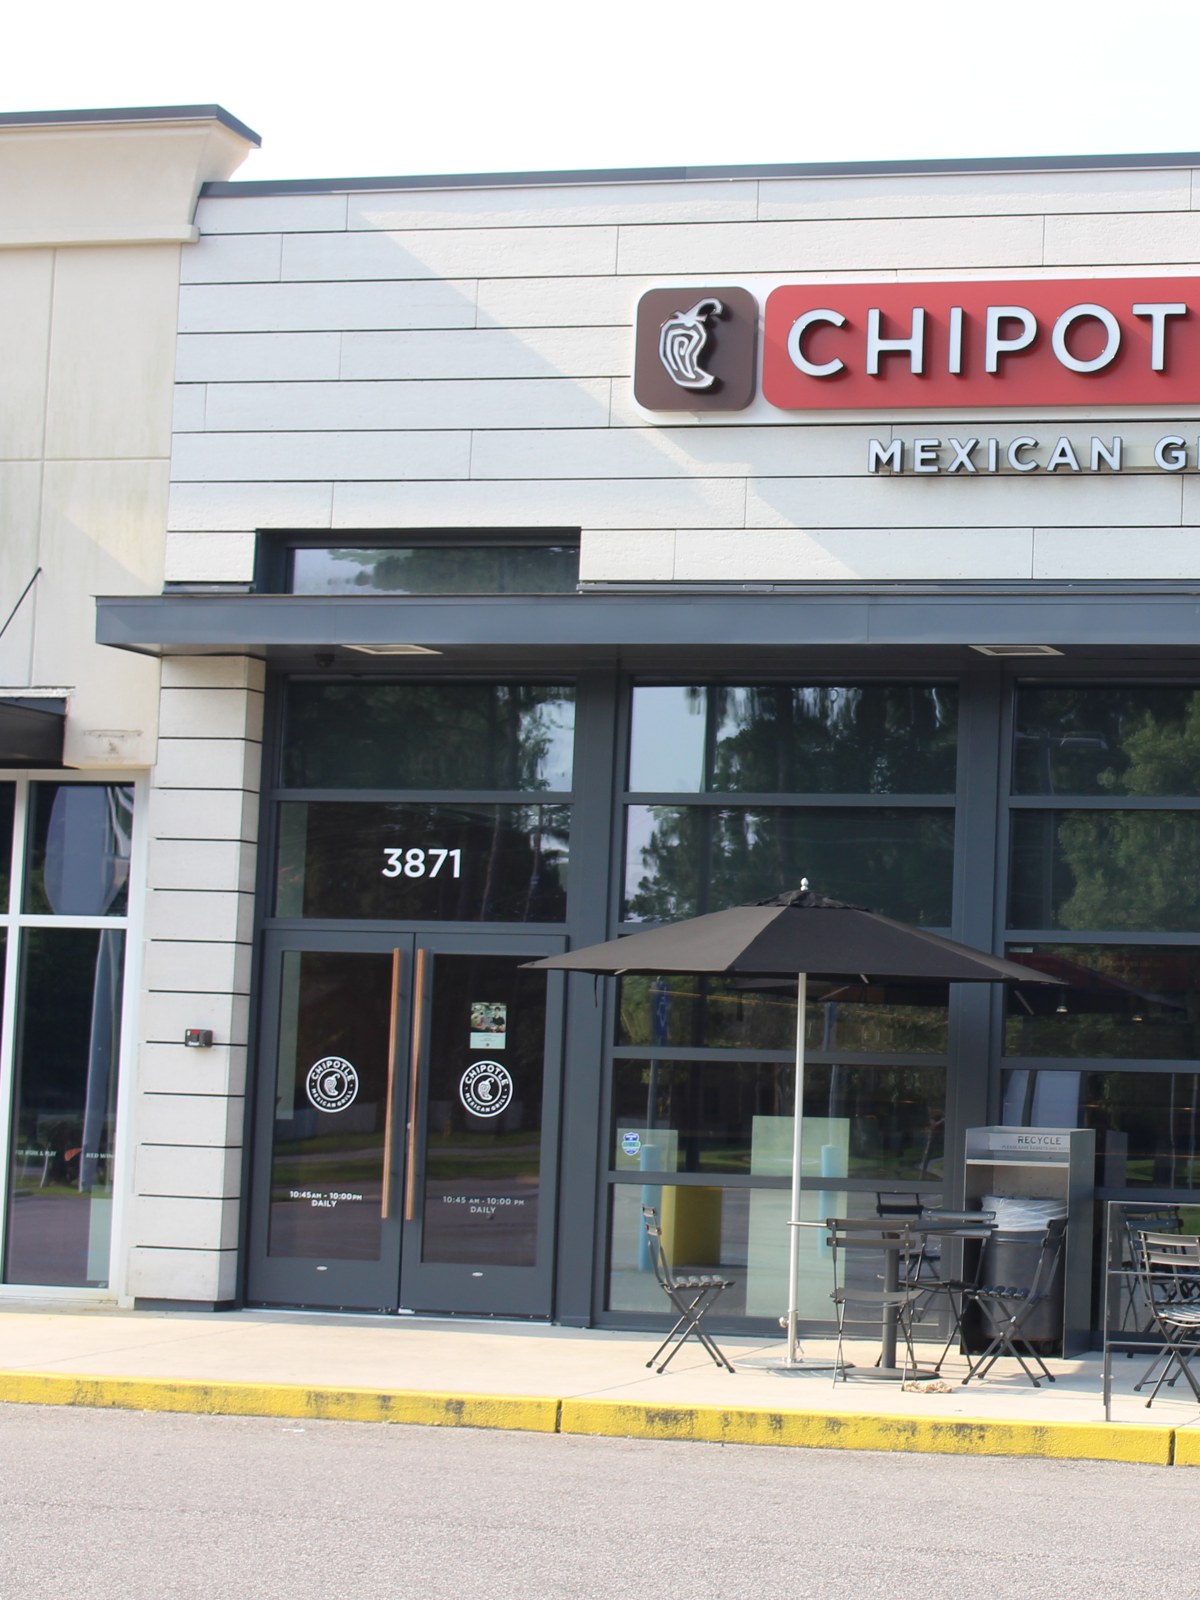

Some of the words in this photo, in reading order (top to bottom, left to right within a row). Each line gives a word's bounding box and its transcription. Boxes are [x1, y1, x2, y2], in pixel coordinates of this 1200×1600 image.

[868, 436, 1124, 474] MEXICAN
[381, 848, 461, 878] 3871
[311, 1060, 355, 1082] CHIPOTLE
[464, 1064, 509, 1086] CHIPOTLE
[311, 1088, 336, 1108] MEXICAN
[337, 1090, 353, 1107] GRILL
[465, 1092, 491, 1112] MEXICAN
[491, 1094, 508, 1111] GRILL
[1017, 1136, 1062, 1145] RECYCLE
[311, 1199, 337, 1207] DAILY
[443, 1196, 466, 1204] 10:45
[487, 1197, 512, 1205] 10:00
[470, 1206, 497, 1214] DAILY
